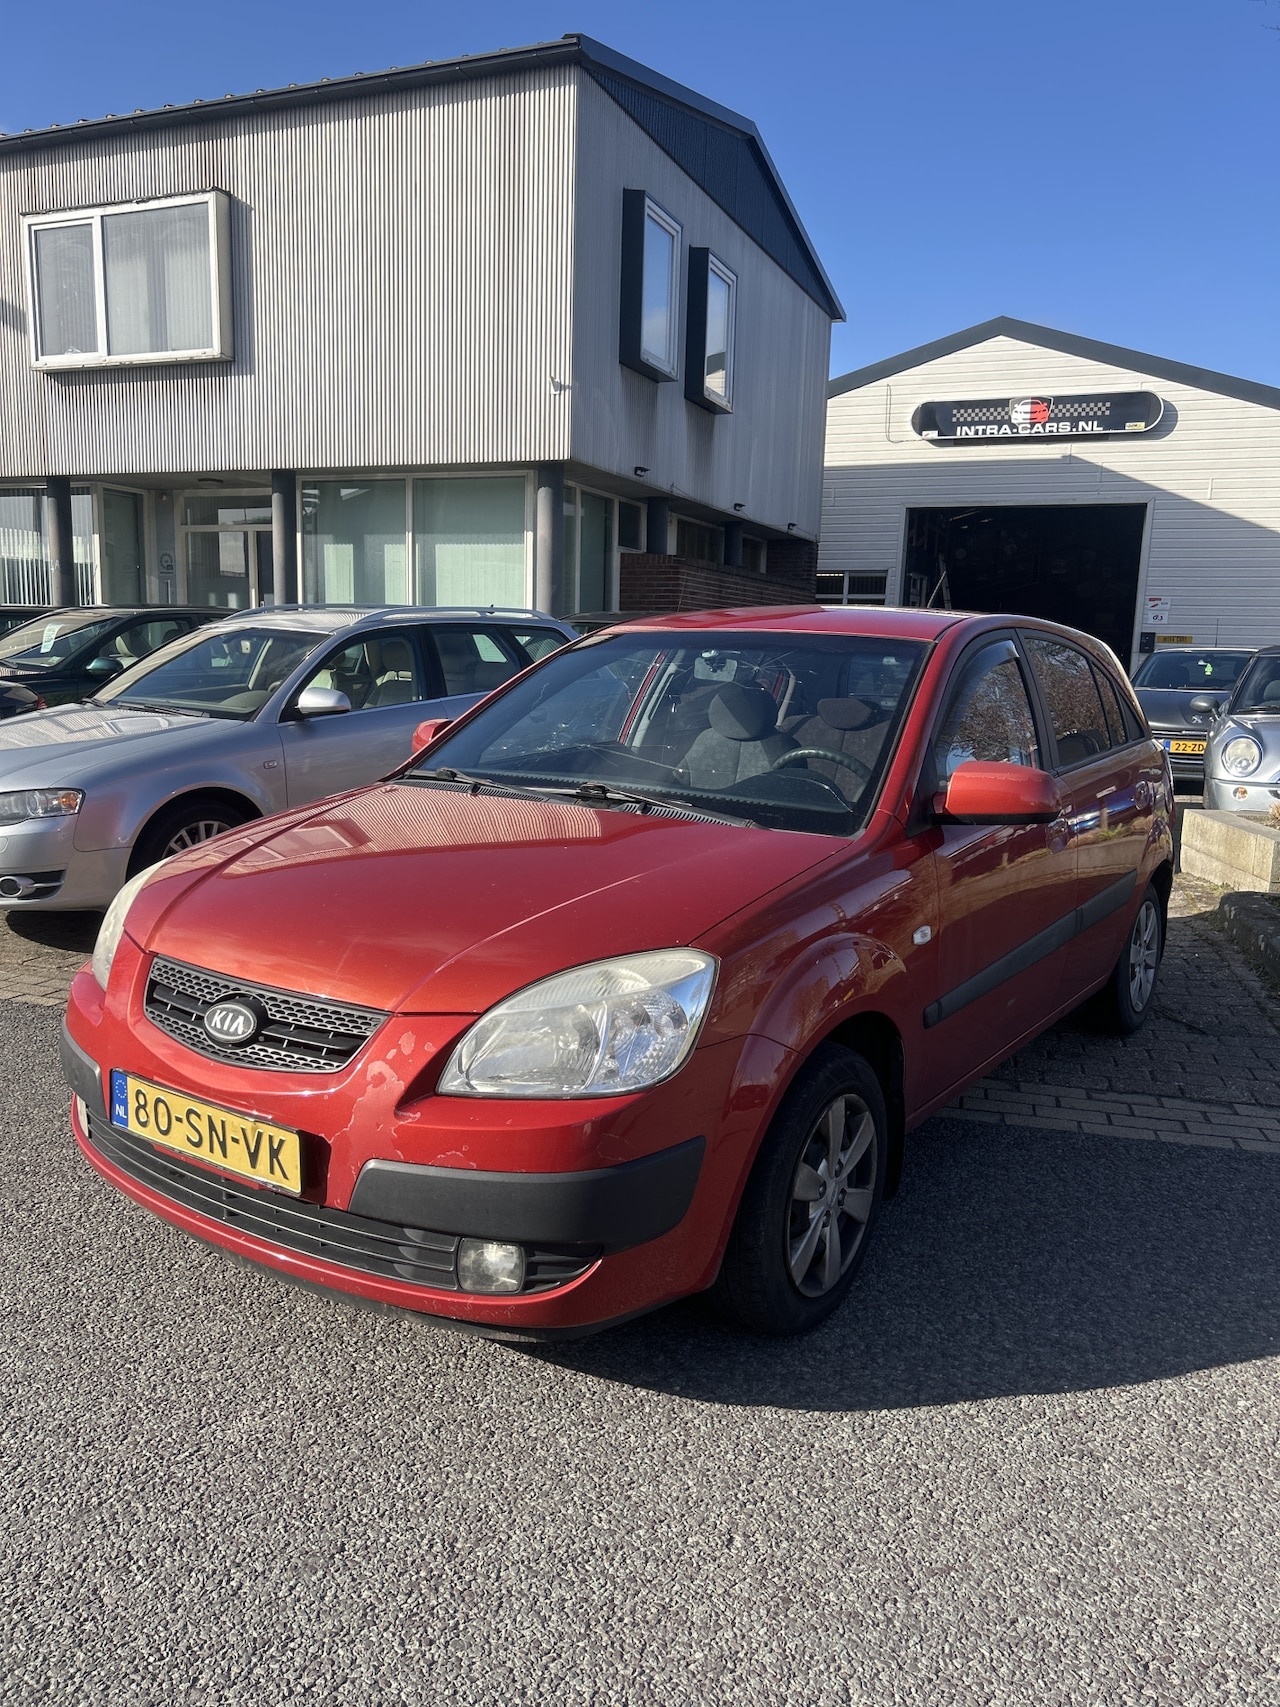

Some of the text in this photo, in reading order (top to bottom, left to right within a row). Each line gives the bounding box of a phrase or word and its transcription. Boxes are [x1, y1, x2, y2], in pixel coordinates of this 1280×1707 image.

[956, 421, 1104, 437] INTRA-CARS.NL
[1175, 742, 1205, 752] 22-ZD
[211, 1009, 245, 1035] KIA
[115, 1103, 128, 1119] NL
[134, 1088, 289, 1181] 80-SN-VK
